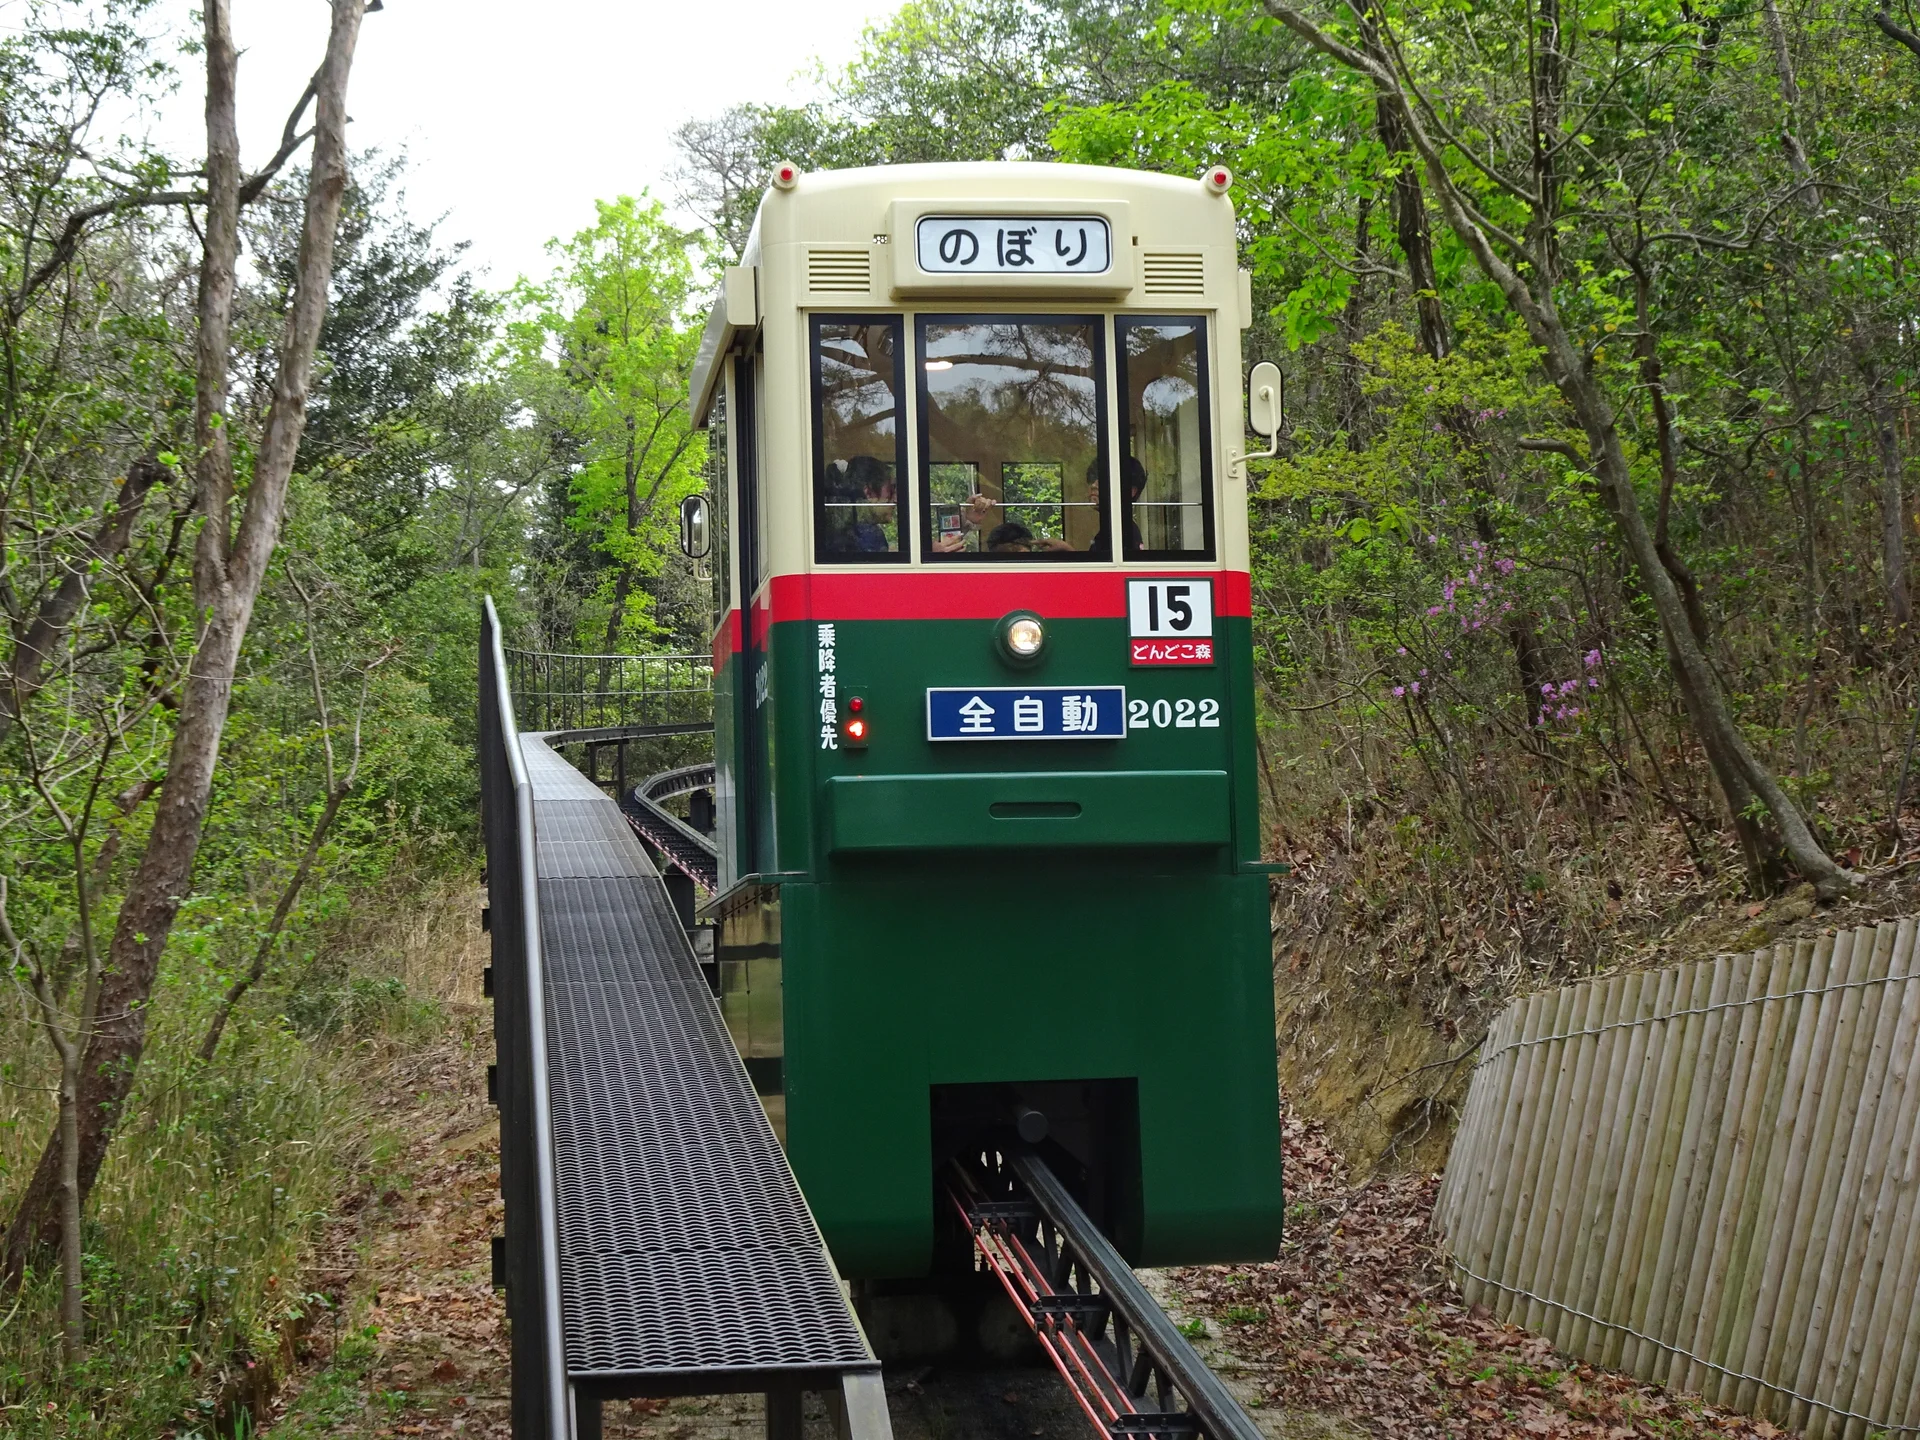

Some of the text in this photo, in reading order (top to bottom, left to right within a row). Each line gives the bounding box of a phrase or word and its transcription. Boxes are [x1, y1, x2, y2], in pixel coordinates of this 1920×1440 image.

[939, 226, 1087, 267] のぼり
[1148, 585, 1193, 632] 15
[1133, 643, 1212, 660] どんどこ森
[817, 623, 839, 750] 乗降者優先
[958, 695, 1098, 733] 全自動
[1127, 698, 1221, 729] 2022
